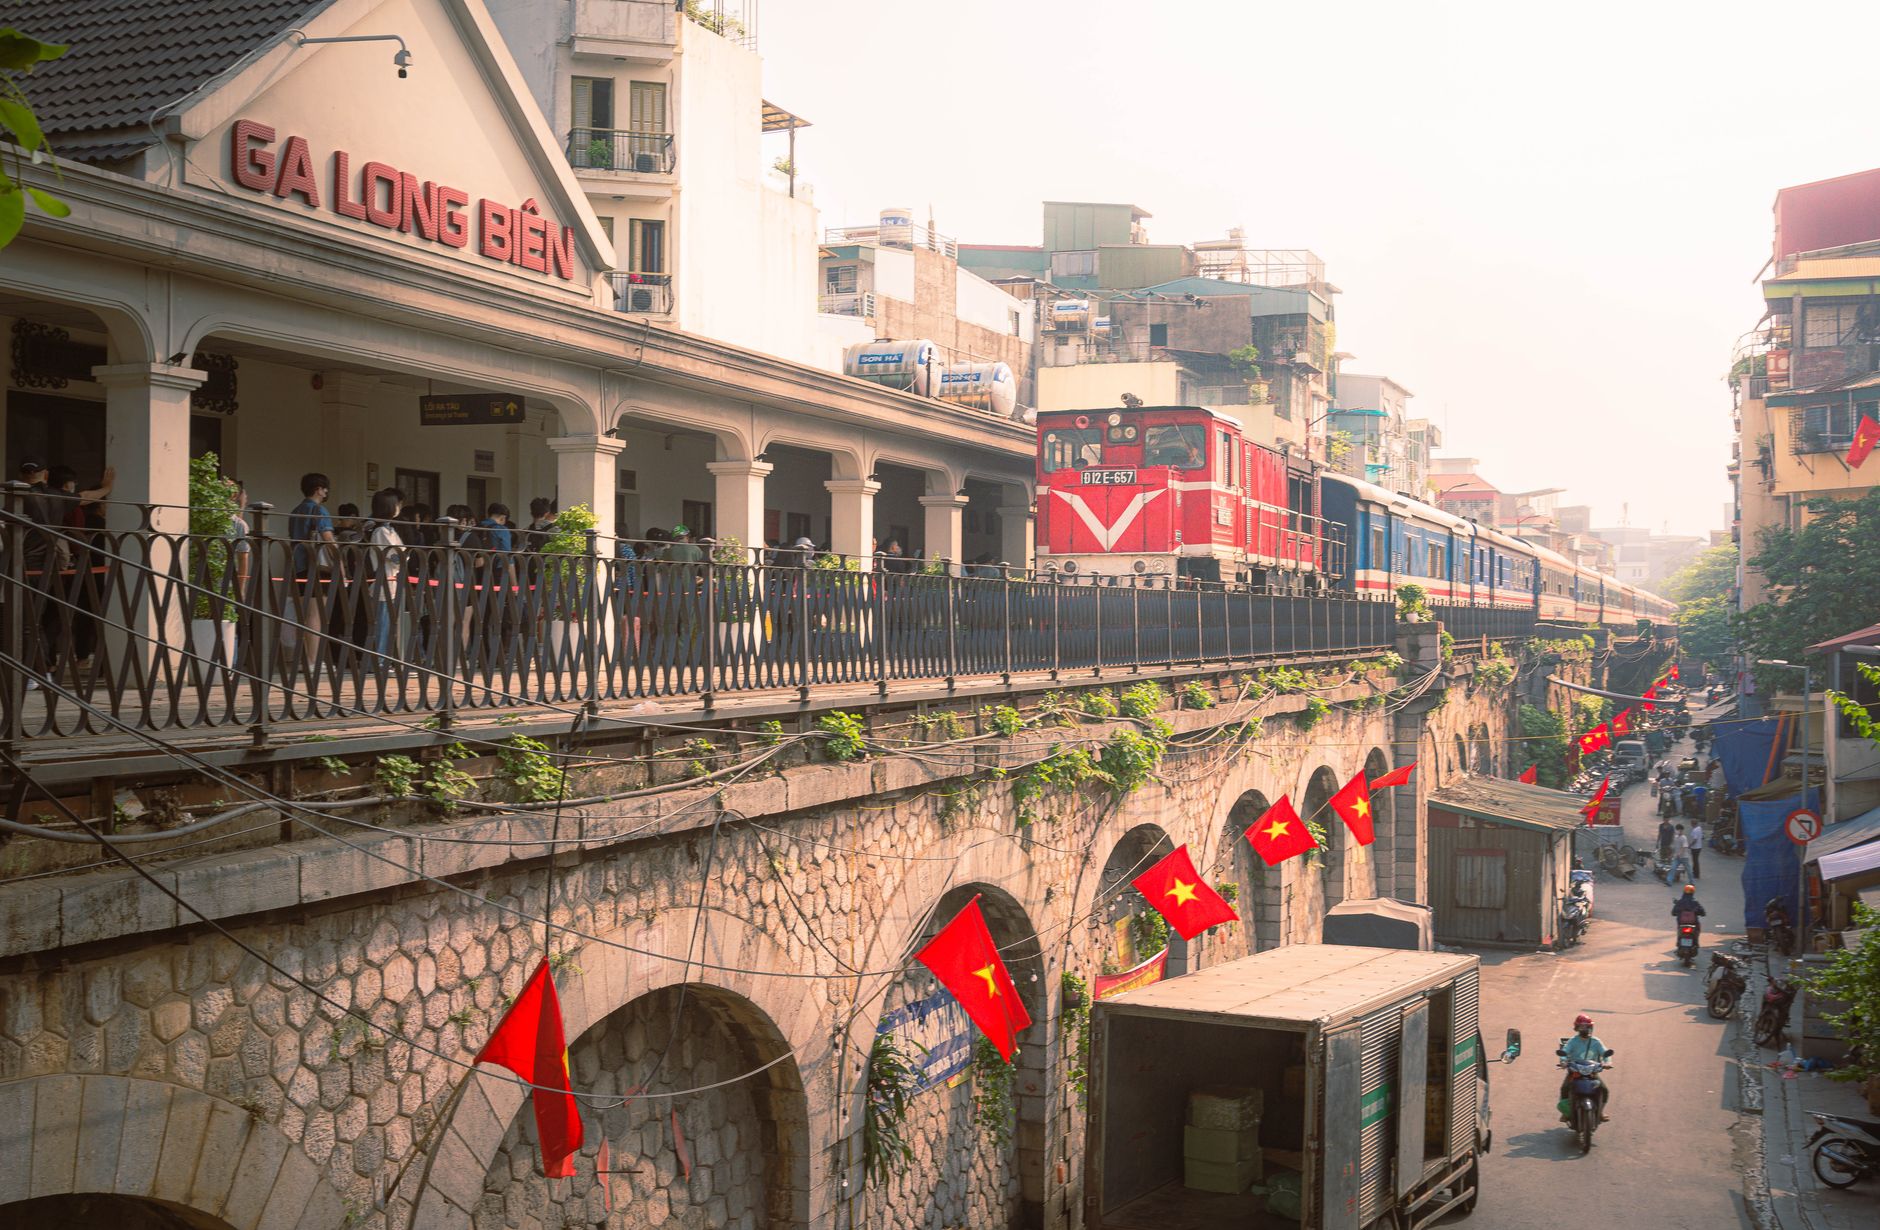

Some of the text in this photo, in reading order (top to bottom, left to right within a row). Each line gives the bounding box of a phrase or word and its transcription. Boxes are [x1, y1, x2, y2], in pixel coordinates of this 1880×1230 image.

[231, 118, 575, 281] GA LONG BIÊN
